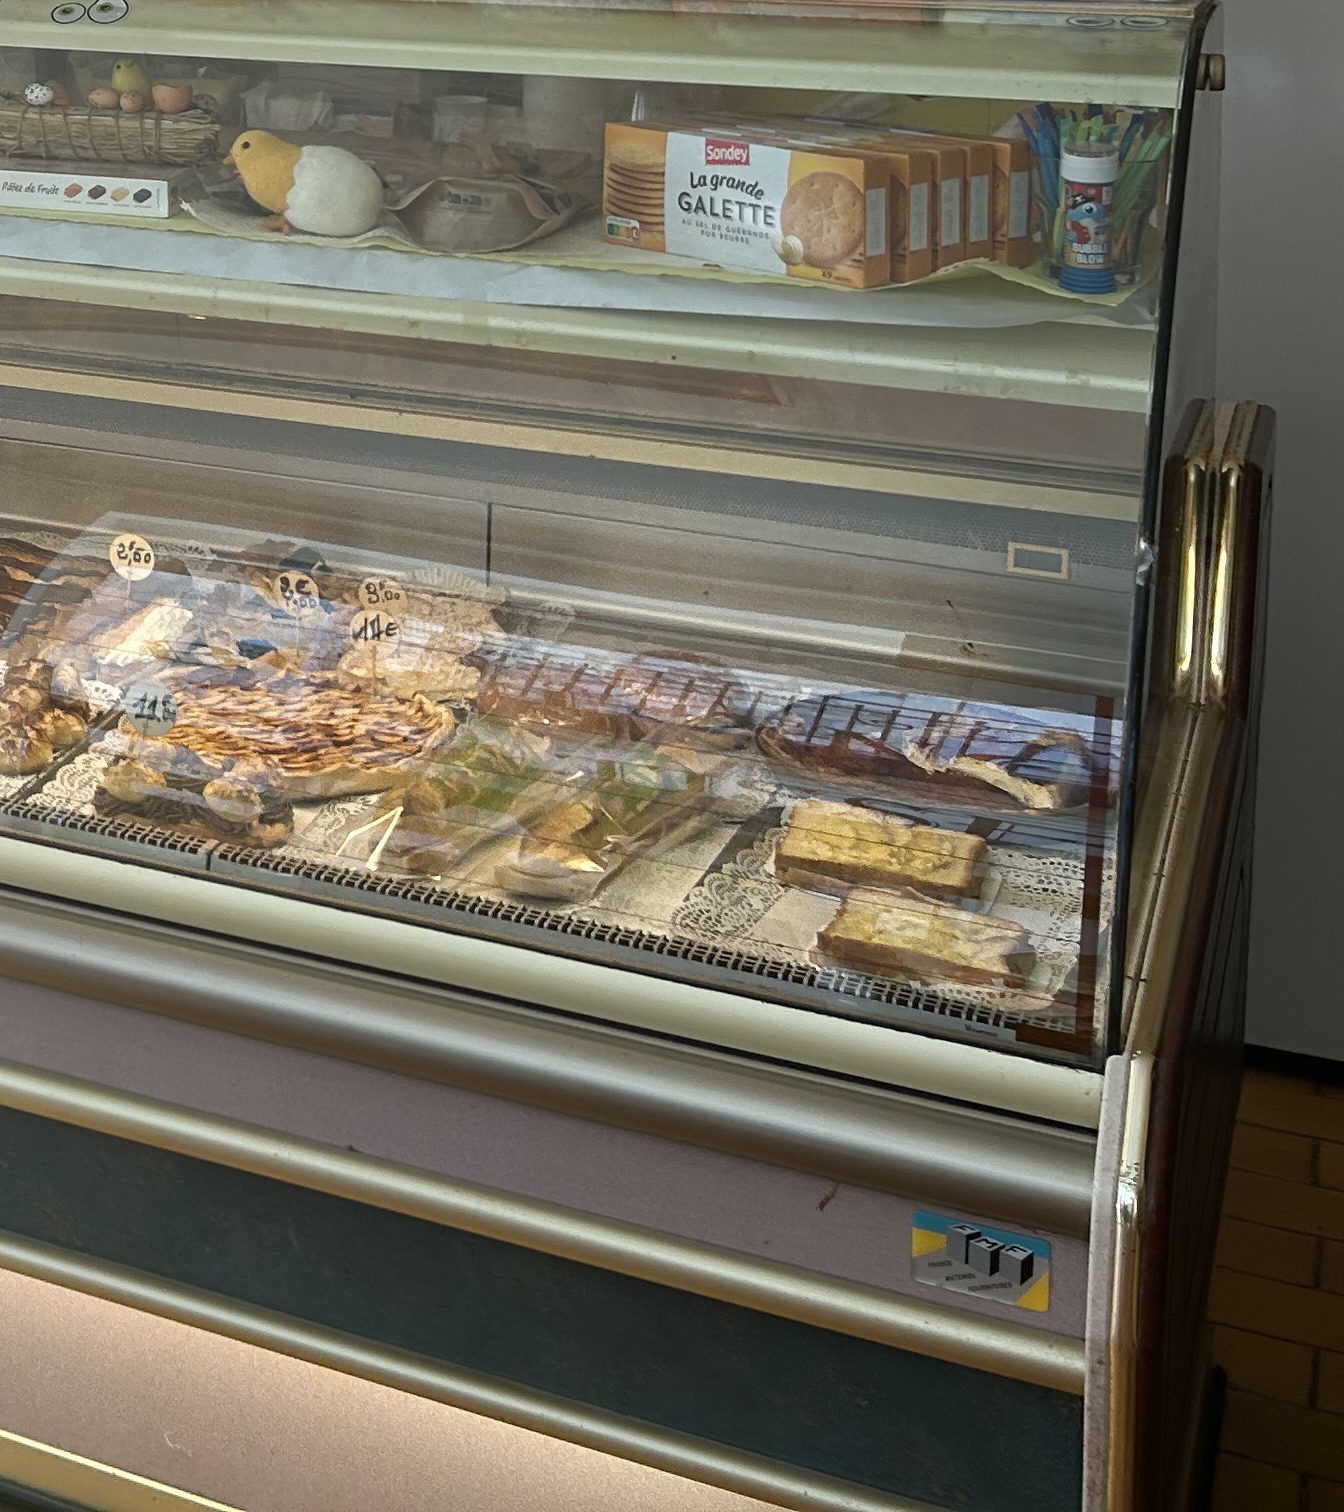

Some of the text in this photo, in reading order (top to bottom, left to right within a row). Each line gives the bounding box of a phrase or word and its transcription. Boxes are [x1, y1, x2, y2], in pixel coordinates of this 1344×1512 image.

[706, 144, 748, 162] Sondey
[690, 171, 765, 200] La grande
[678, 191, 776, 227] GALETTE
[1076, 254, 1105, 264] BLOW
